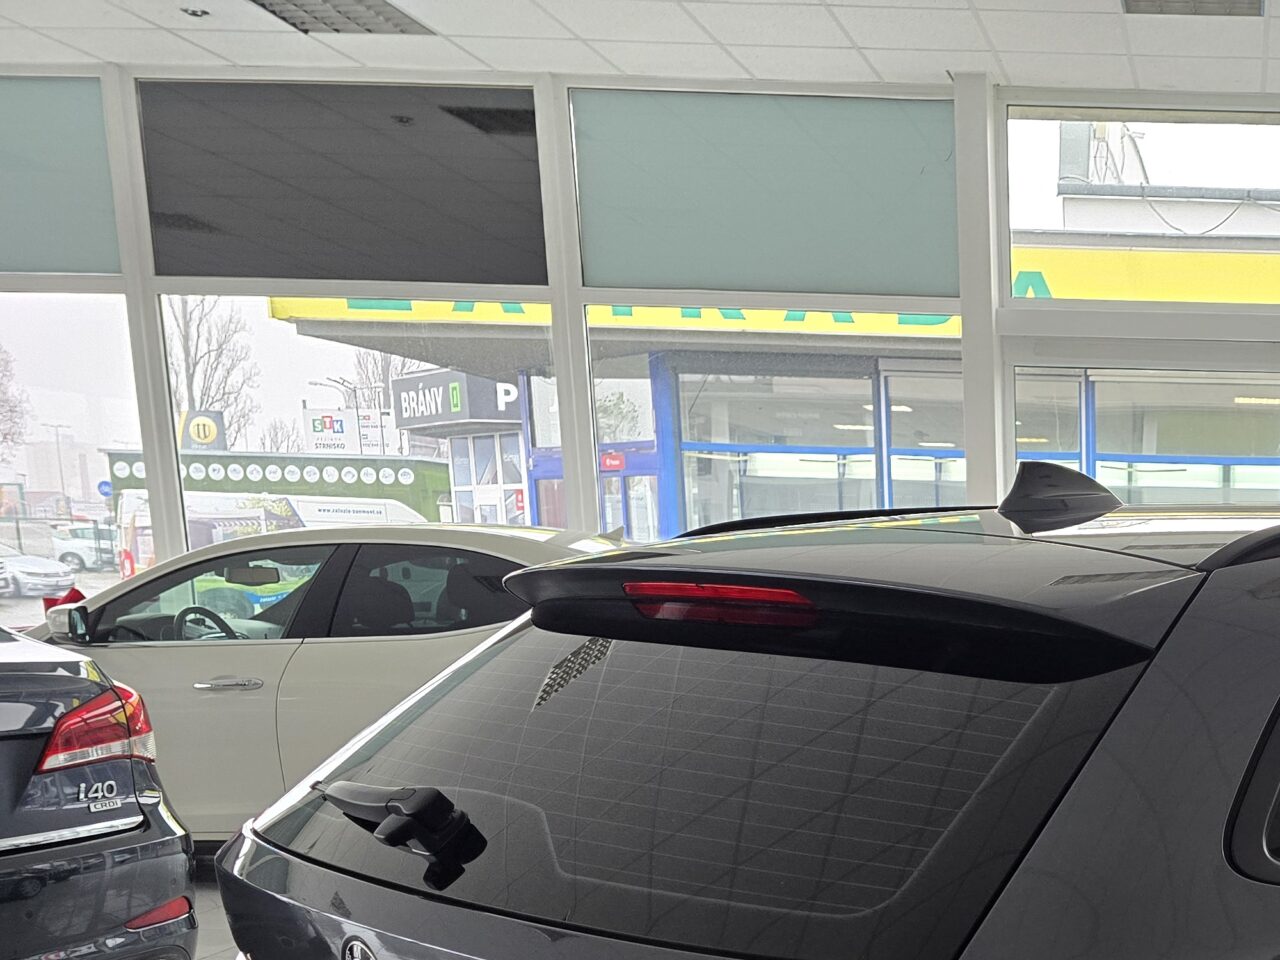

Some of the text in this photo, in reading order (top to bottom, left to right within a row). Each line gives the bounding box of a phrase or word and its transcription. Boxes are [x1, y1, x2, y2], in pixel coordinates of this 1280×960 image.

[401, 383, 443, 418] BRÁNY
[312, 416, 344, 433] STK
[79, 780, 117, 801] i40
